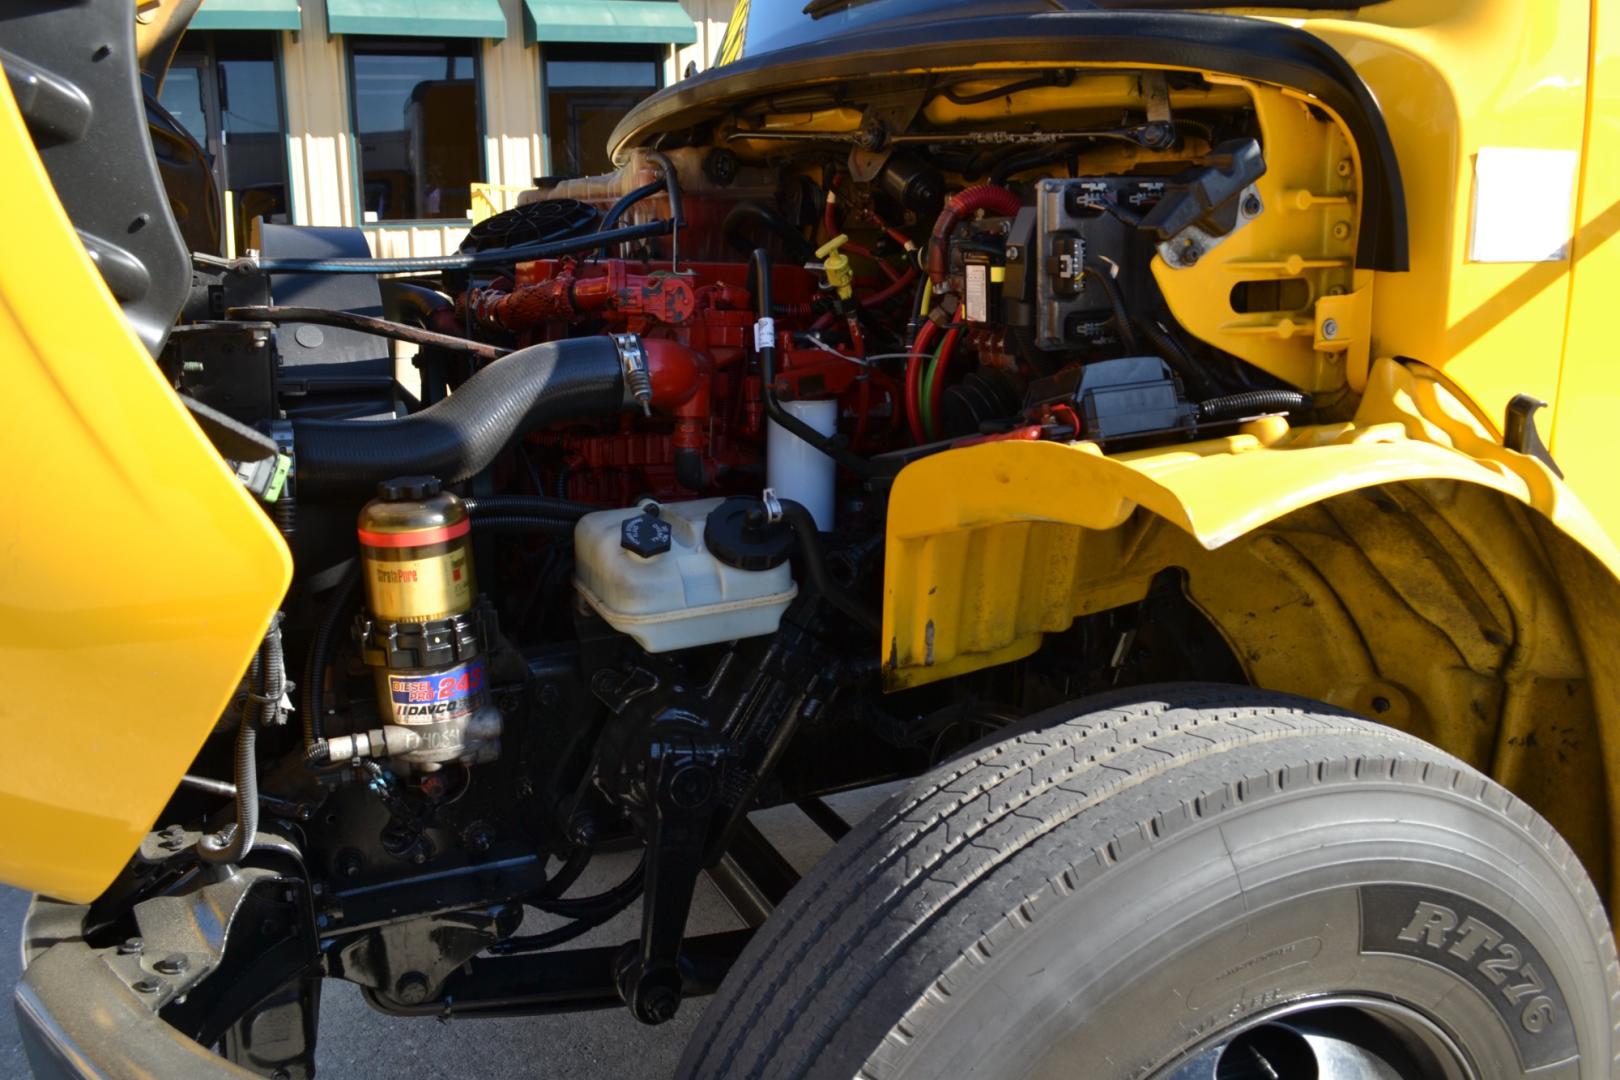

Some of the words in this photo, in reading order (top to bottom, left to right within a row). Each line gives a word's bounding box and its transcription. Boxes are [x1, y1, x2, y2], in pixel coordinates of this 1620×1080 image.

[392, 681, 432, 693] DIESEL
[408, 691, 435, 702] PRO
[407, 701, 457, 716] DAVCO
[1397, 901, 1558, 1033] RT276
